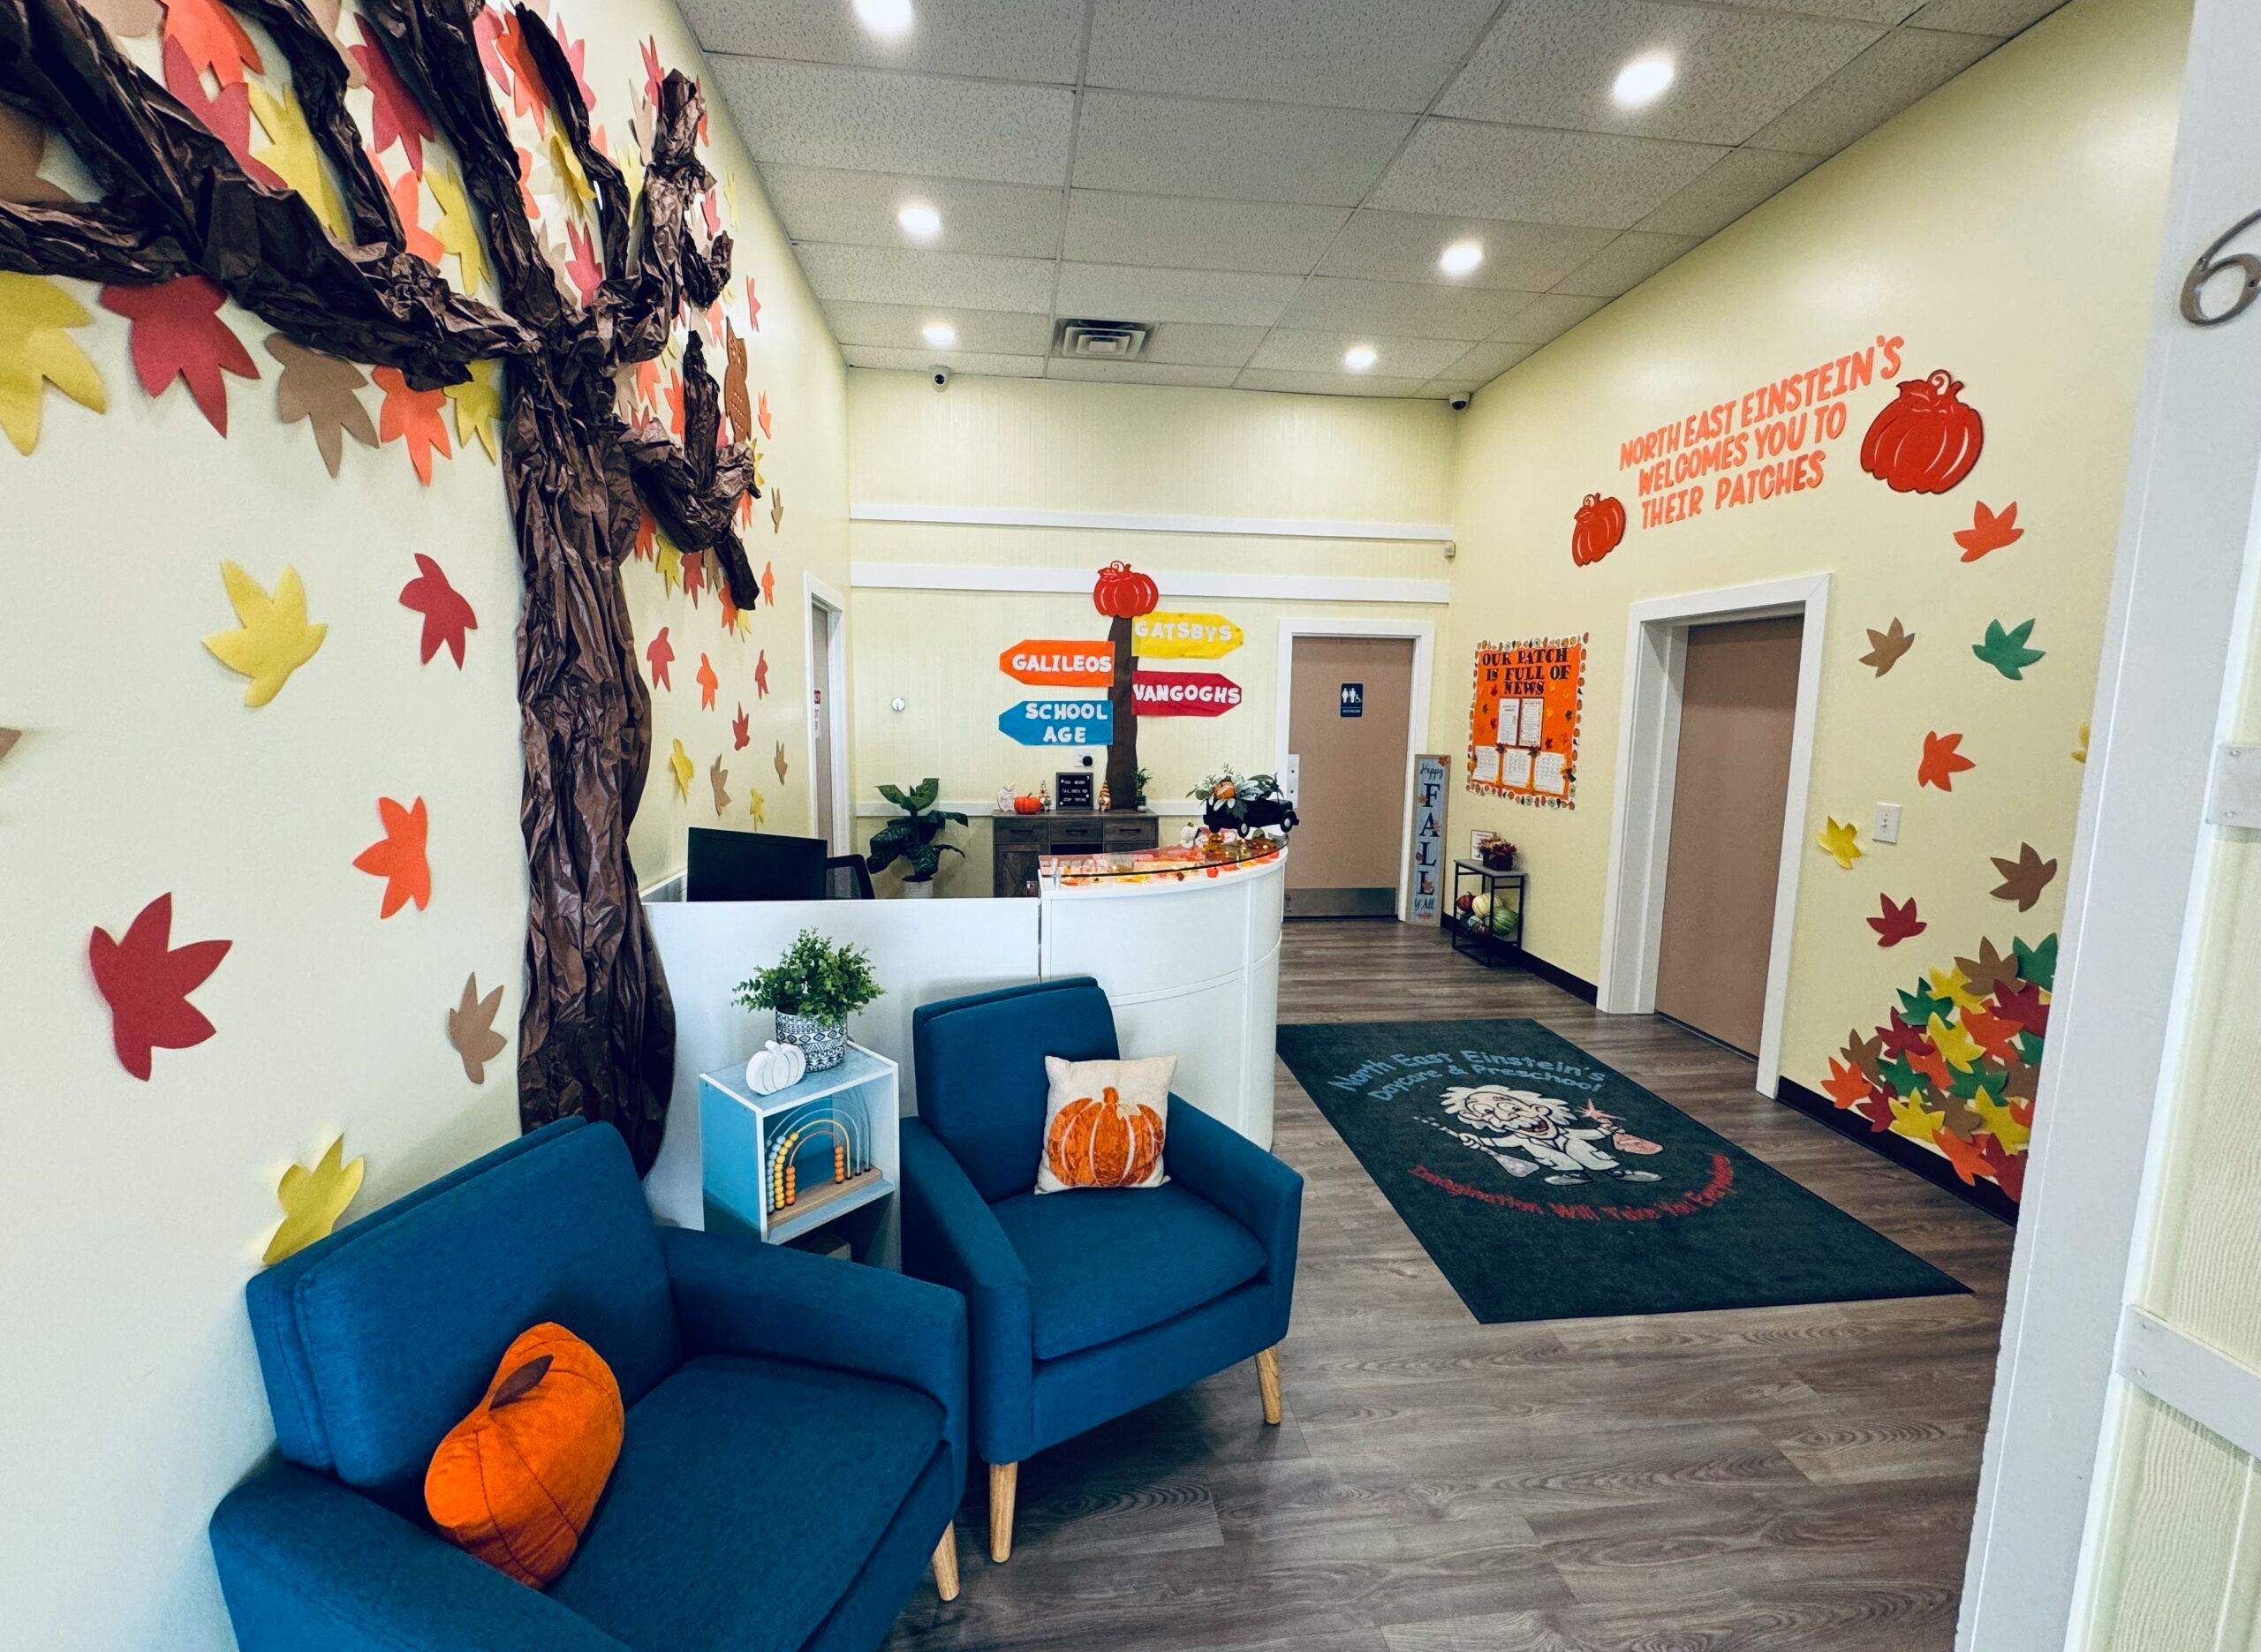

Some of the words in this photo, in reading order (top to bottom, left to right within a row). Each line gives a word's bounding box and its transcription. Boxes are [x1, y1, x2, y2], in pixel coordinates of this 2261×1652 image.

[1620, 421, 1682, 471] NORTH
[1683, 400, 1737, 447] EAST
[1740, 335, 1904, 426] EINSTEIN'S
[1637, 432, 1750, 497] WELCOMES
[1753, 412, 1808, 460] YOU
[1814, 402, 1848, 442] TO
[1641, 486, 1704, 530] THEIR
[1714, 449, 1826, 510] PATCHES
[1134, 621, 1233, 642] GATSBYS
[1011, 653, 1112, 673] GALILEOS
[1483, 652, 1512, 666] OUR
[1517, 647, 1569, 665] PATCH
[1486, 668, 1499, 681] IS
[1504, 666, 1544, 680] FULL
[1549, 665, 1571, 679] OF
[1132, 683, 1241, 705] VANGOGHS
[1503, 681, 1544, 695] NEWS
[1025, 703, 1108, 720] SCHOOL
[1042, 726, 1086, 743] AGE
[1420, 763, 1444, 781] Happy
[1417, 782, 1441, 895] FALL
[1327, 1060, 1396, 1092] North
[1390, 1052, 1453, 1068] East
[1460, 1049, 1606, 1082] Einstein's
[1367, 1067, 1443, 1103] Daycare
[1448, 1064, 1469, 1076] &
[1471, 1063, 1602, 1093] Preschool
